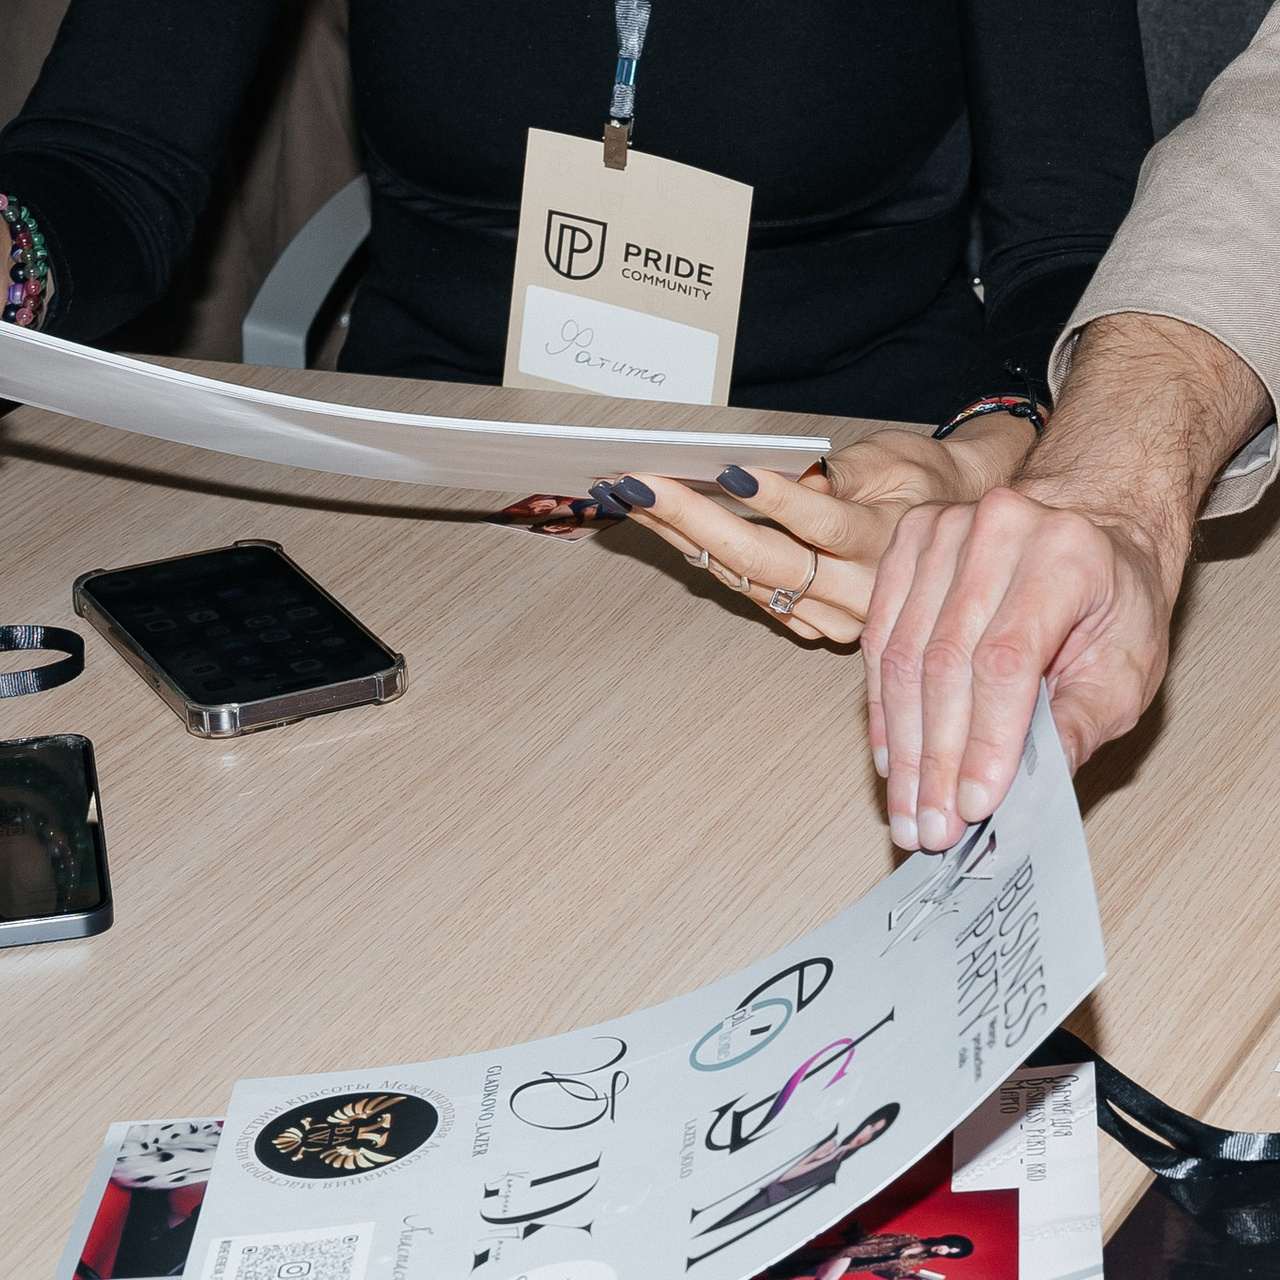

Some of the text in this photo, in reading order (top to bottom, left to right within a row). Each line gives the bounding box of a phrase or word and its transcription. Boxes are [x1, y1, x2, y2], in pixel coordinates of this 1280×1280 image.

[621, 267, 712, 301] COMMUNITY
[623, 242, 715, 287] PRIDE
[956, 908, 1000, 1037] PARTY
[997, 863, 1048, 1048] BUSINESS
[235, 1080, 456, 1190] Международная Ассоциация мастеров индустрии красоты
[472, 1065, 503, 1158] GLADKOVO_LAZER
